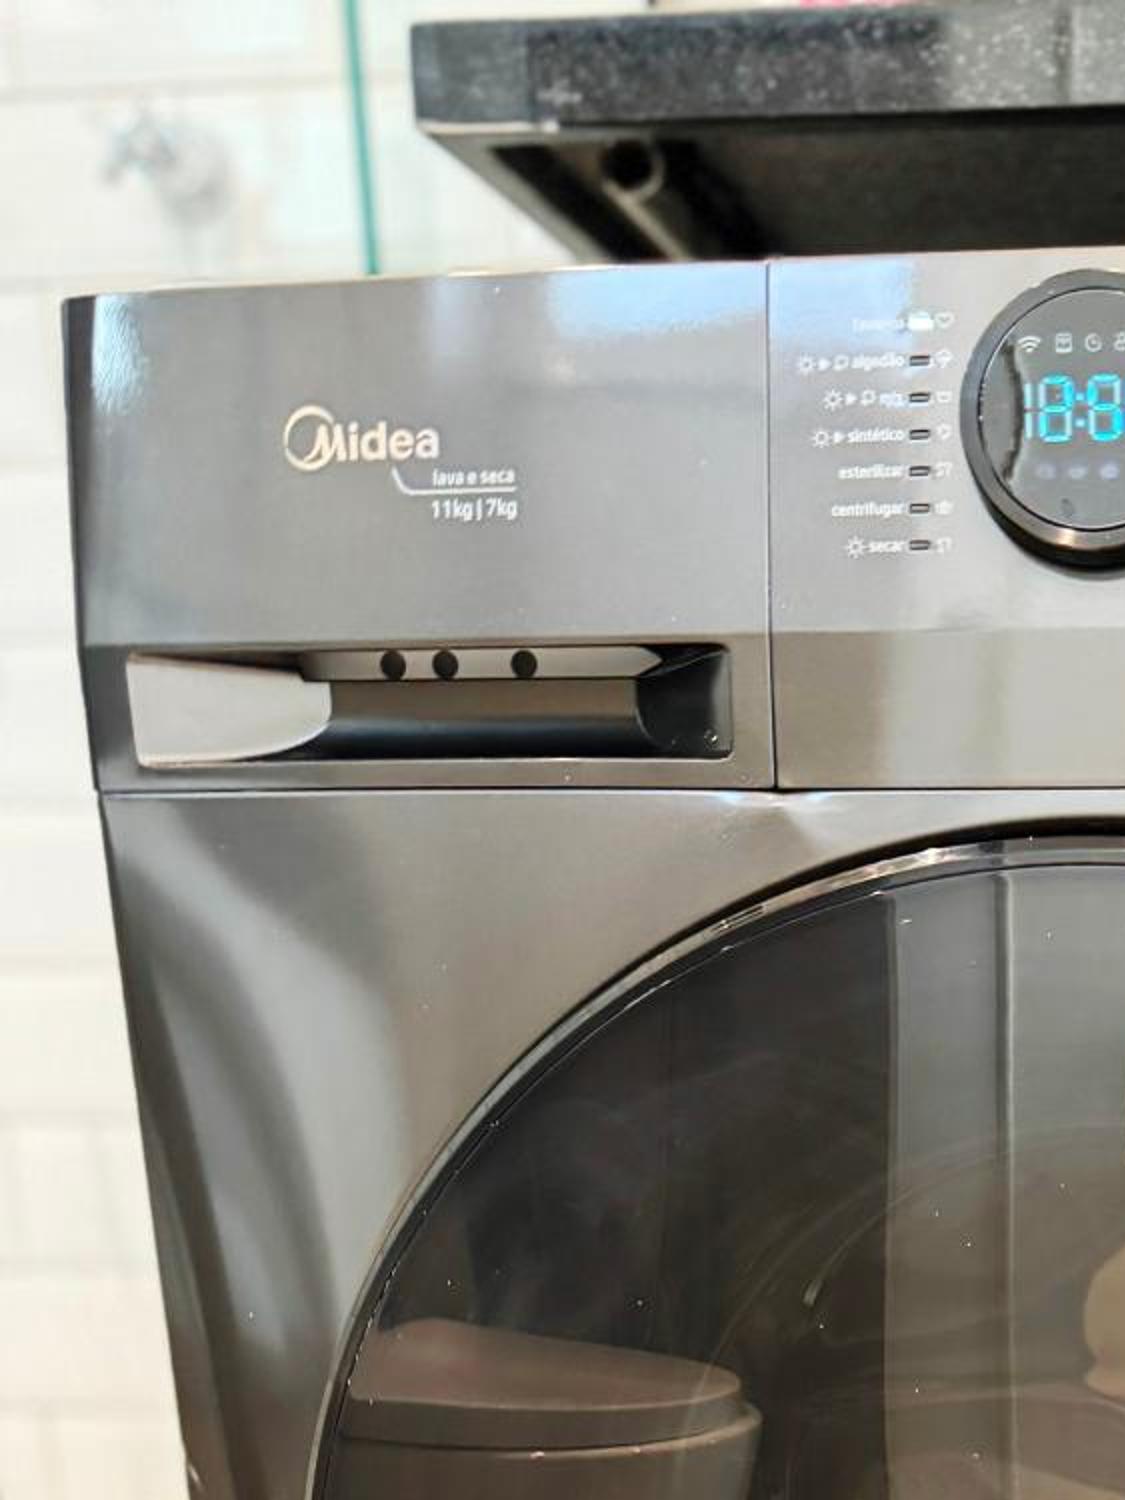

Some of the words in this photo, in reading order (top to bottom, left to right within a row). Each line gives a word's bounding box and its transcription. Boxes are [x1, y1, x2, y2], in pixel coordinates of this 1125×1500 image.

[284, 405, 440, 471] Midea
[848, 426, 905, 443] sintético
[432, 469, 465, 486] lava
[466, 472, 477, 484] e
[479, 469, 516, 485] seca
[432, 499, 473, 521] 11kg
[487, 497, 518, 520] 7kg
[832, 501, 906, 518] centrifugar
[868, 540, 906, 553] secar
